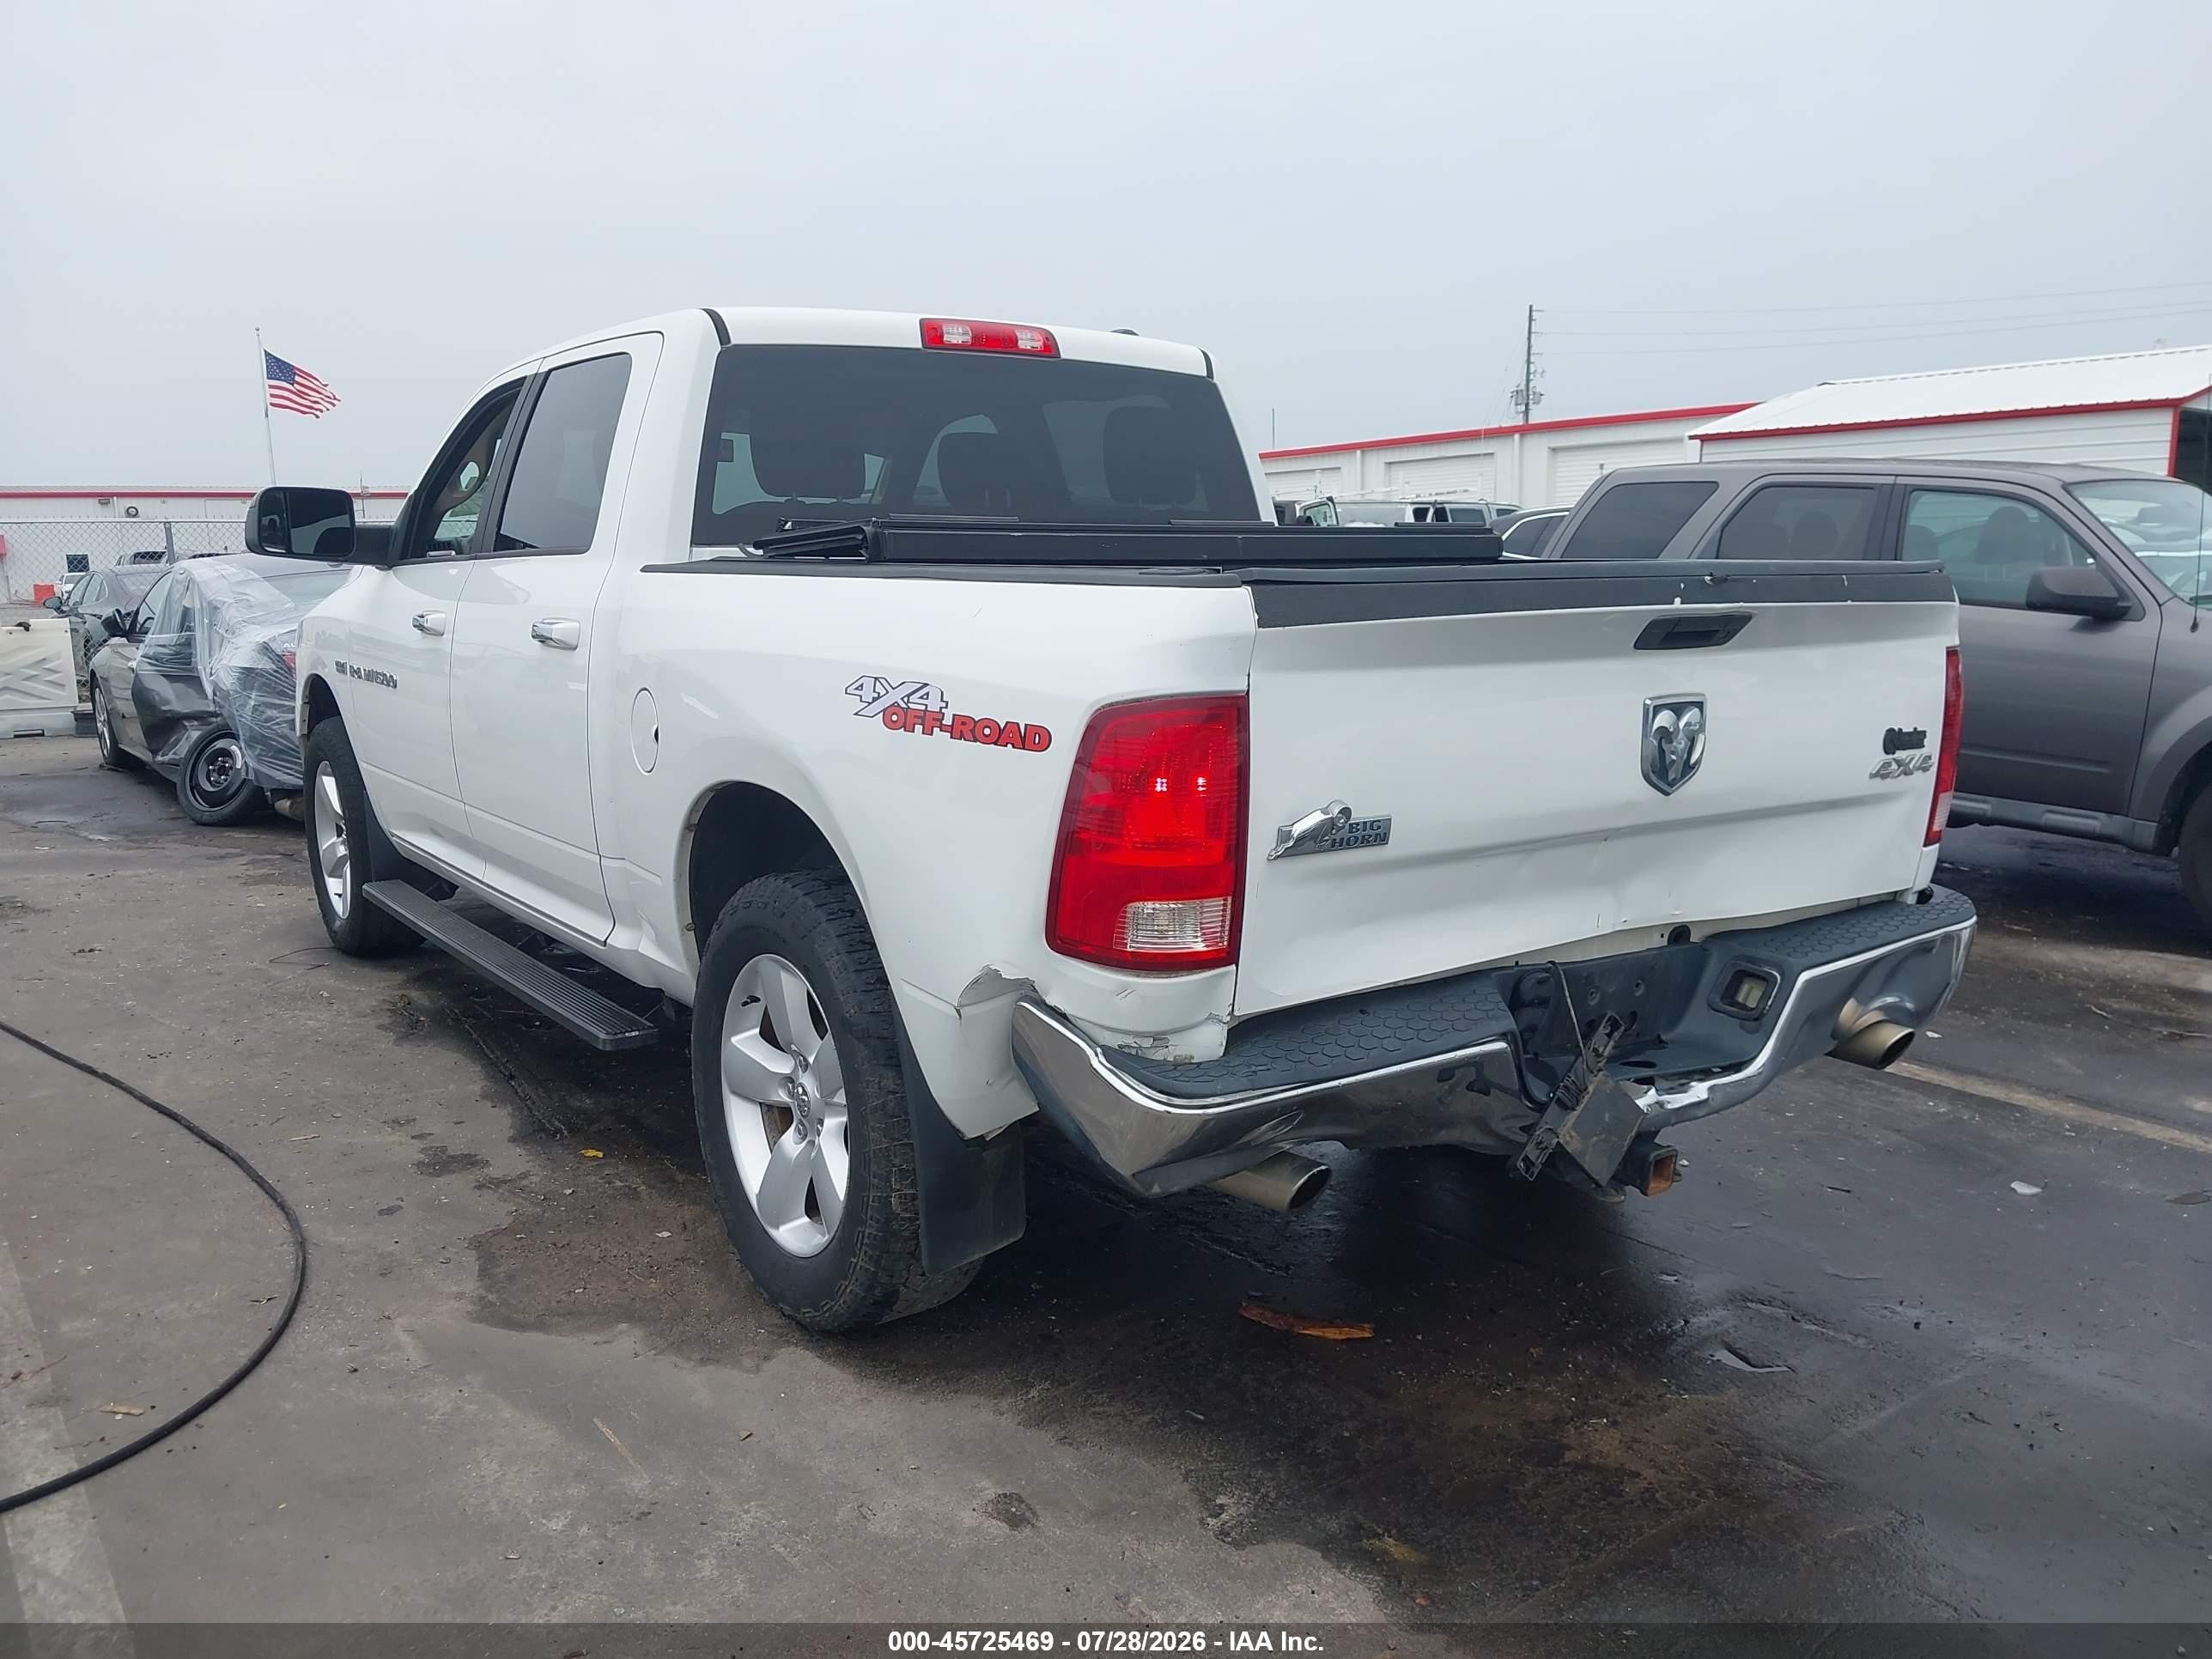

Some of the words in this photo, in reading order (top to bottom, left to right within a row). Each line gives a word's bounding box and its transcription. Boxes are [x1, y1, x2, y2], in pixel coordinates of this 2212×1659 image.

[882, 704, 1053, 753] OFF-ROAD
[1348, 820, 1382, 835] BIG
[1331, 831, 1388, 848] HORN
